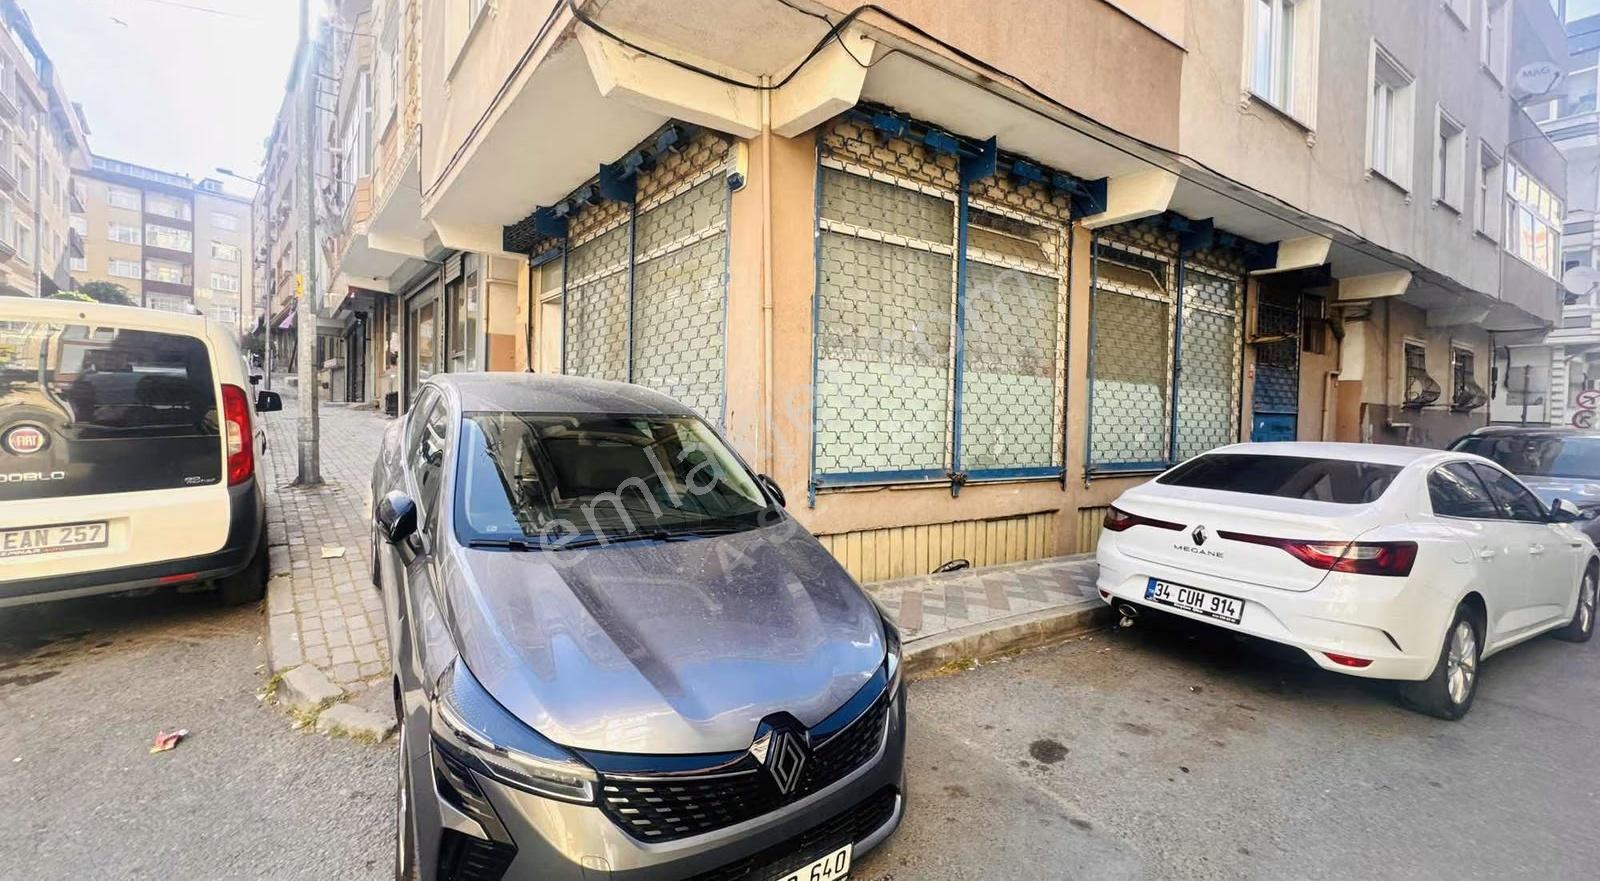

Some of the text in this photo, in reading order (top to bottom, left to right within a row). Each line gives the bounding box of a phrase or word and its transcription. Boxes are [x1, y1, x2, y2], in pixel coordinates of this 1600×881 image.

[3, 525, 102, 550] EAN 257
[1173, 545, 1224, 558] MEGANE
[1155, 583, 1170, 599] 34
[1177, 588, 1205, 608] CUH
[1210, 597, 1235, 616] 914
